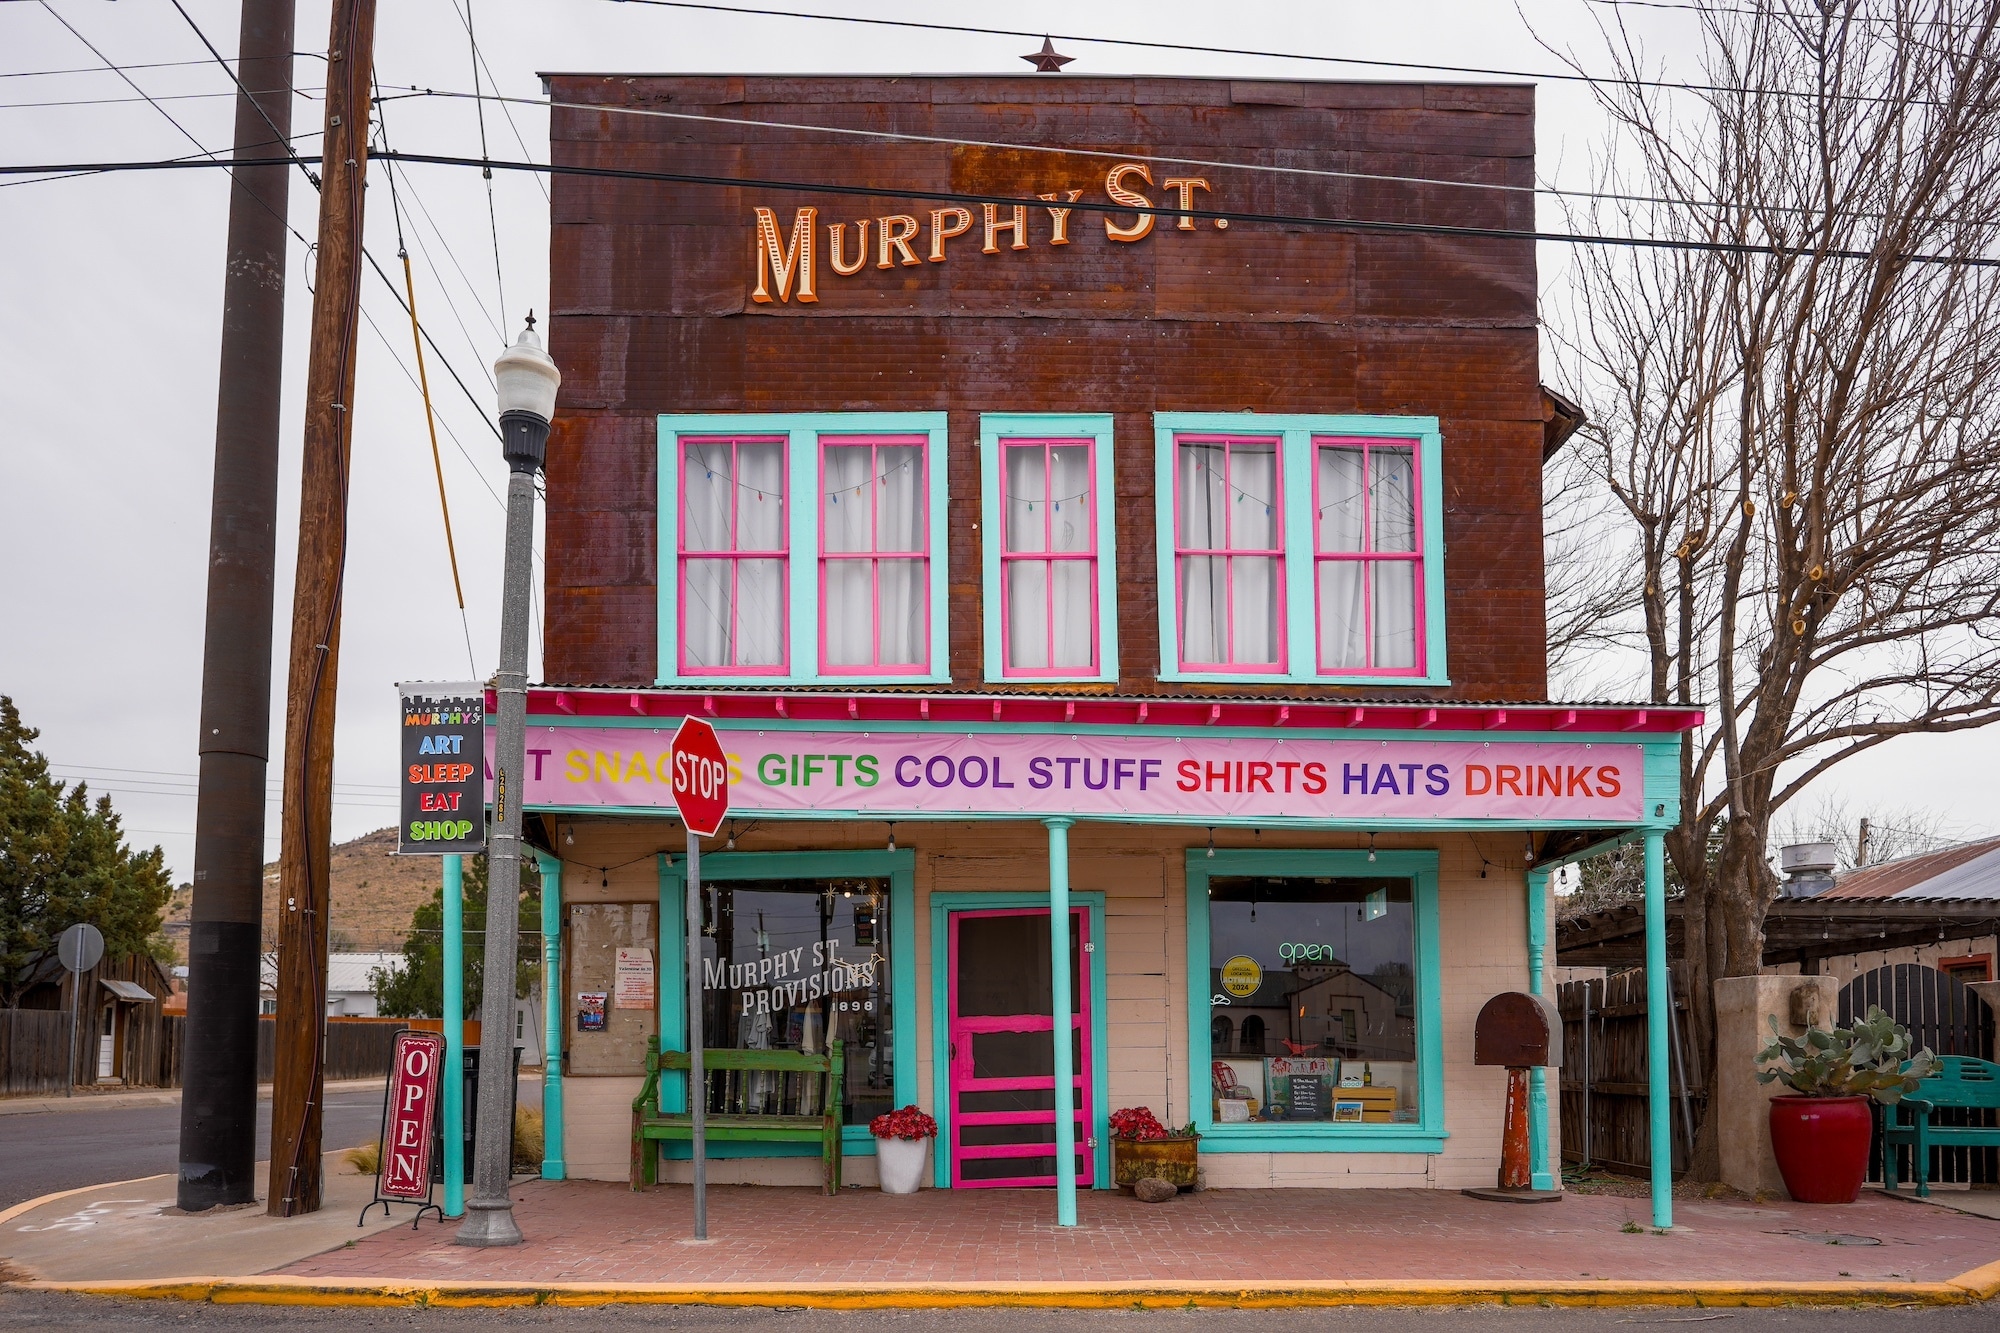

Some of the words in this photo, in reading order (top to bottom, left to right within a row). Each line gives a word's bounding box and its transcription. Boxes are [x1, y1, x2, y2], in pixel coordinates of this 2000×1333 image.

[752, 189, 1084, 304] MURPHY
[1104, 162, 1229, 243] ST.
[404, 712, 472, 727] MURPHY
[405, 706, 481, 714] HISTORIC
[419, 735, 464, 755] ART
[408, 763, 475, 784] SLEEP
[564, 749, 744, 787] SNACS
[757, 753, 880, 787] GIFTS
[894, 754, 1015, 789] COOL
[1028, 756, 1162, 791] STUFF
[1176, 759, 1327, 795] SHIRTS
[1342, 763, 1450, 796] HATS
[1465, 764, 1622, 798] DRINKS
[674, 750, 725, 801] STOP
[420, 791, 463, 812] EAT
[409, 820, 474, 841] SHOP
[1279, 942, 1333, 963] open
[703, 946, 804, 990] MURPHY
[741, 961, 875, 1017] PROVISIONS
[831, 1001, 873, 1012] 1898
[393, 1050, 428, 1182] OPEN
